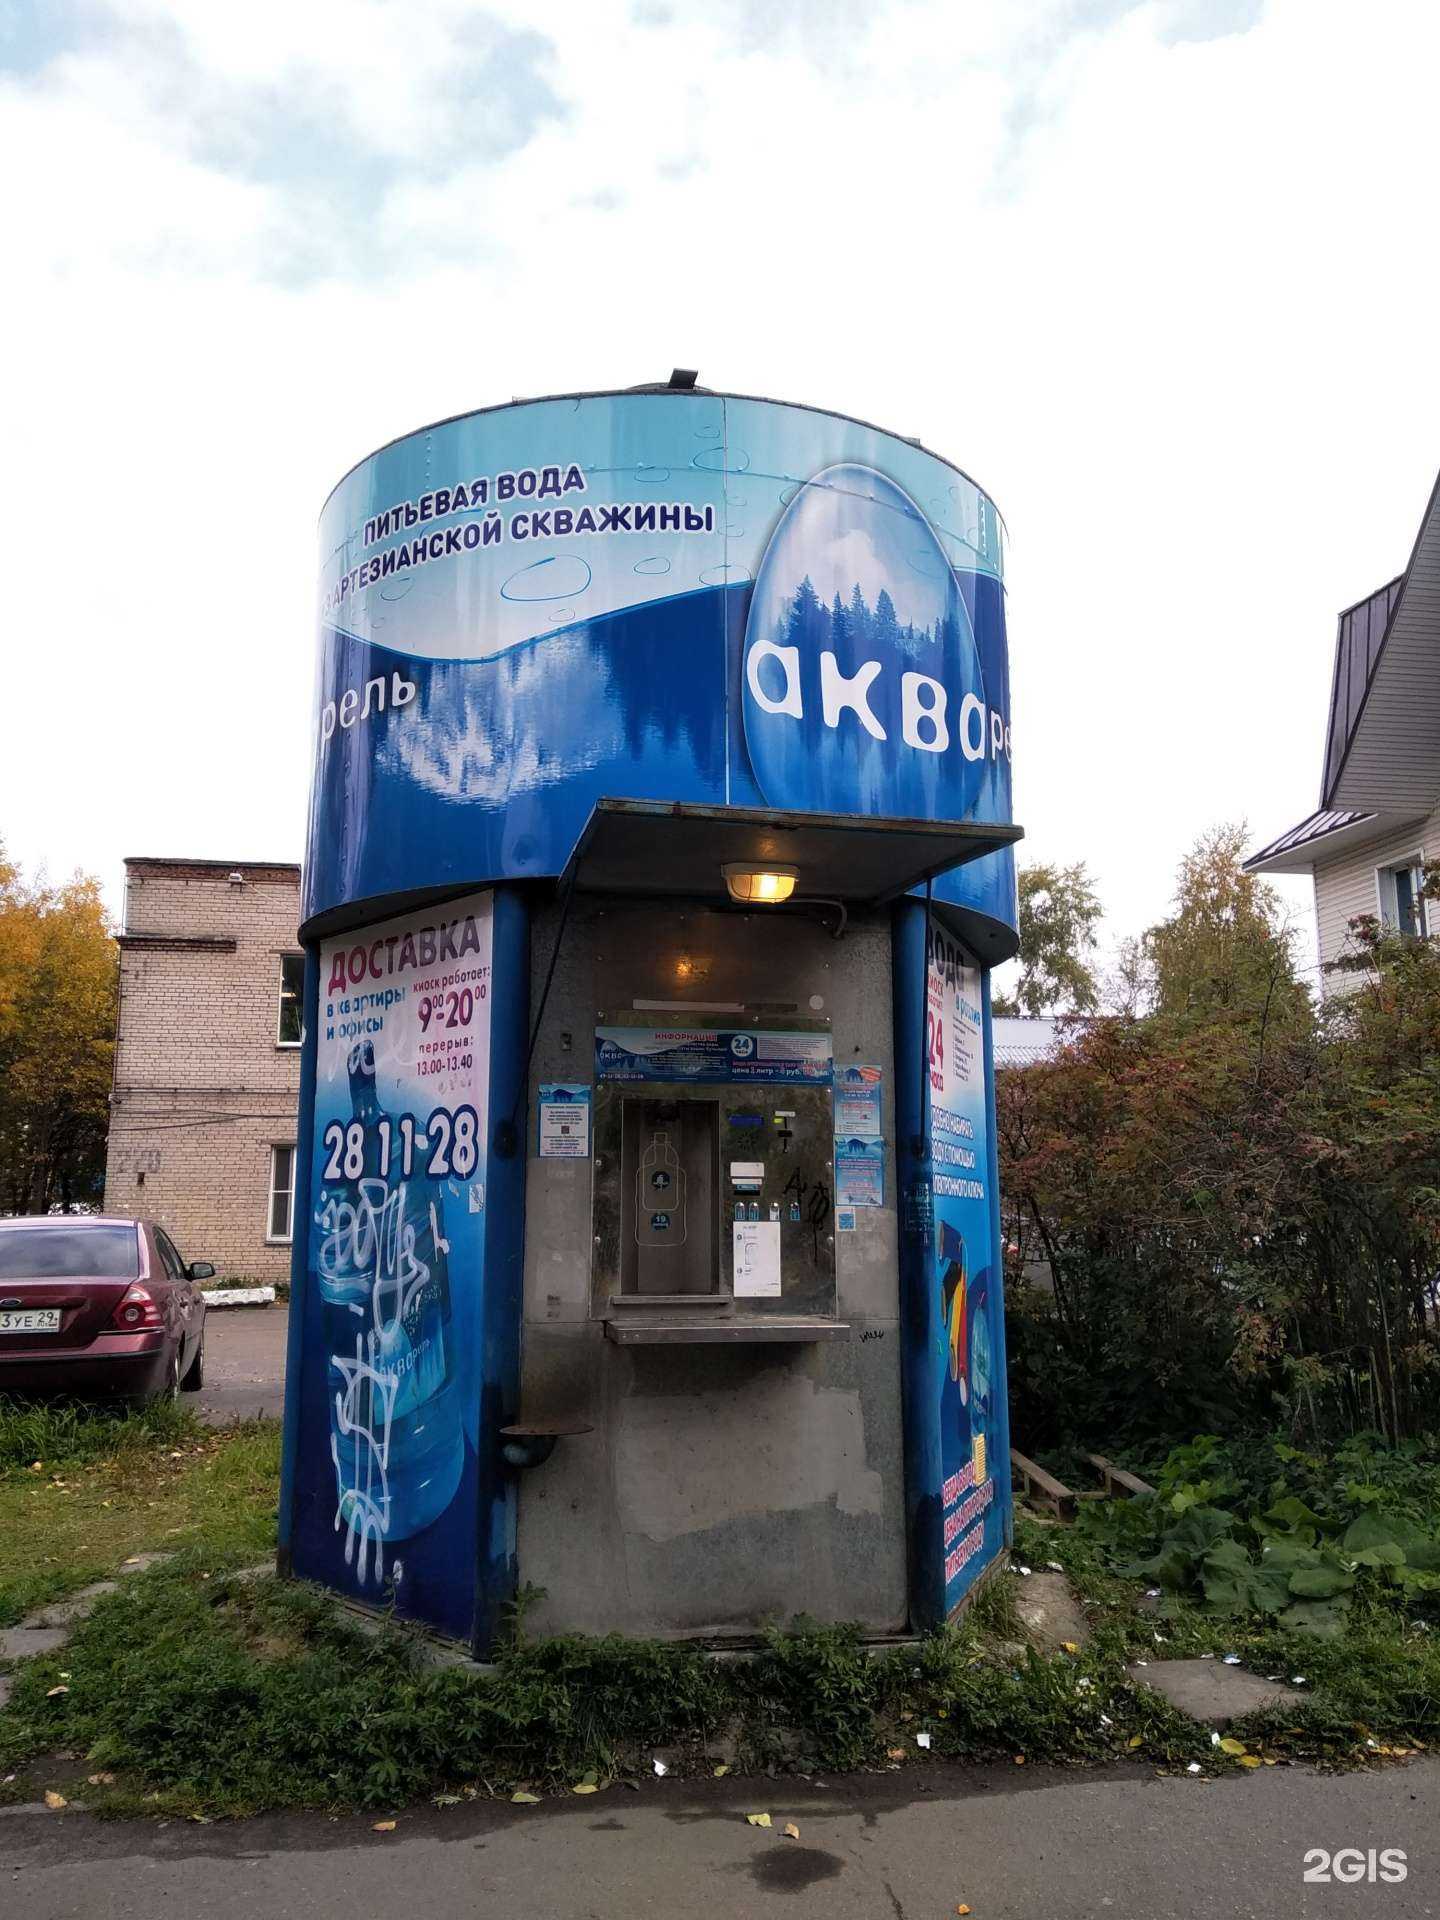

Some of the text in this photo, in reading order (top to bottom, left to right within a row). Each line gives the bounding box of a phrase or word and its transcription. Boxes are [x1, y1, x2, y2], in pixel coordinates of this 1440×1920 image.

[364, 465, 586, 547] ПИТЬЕВАЯ ВОДА
[332, 504, 713, 609] АРТЕЗИАНСКОЙ СКВАЖИНЫ
[328, 915, 481, 998] ДОСТАВКА
[413, 965, 491, 993] киоск работает:
[416, 1053, 474, 1076] 13.00-13.40
[419, 1035, 474, 1055] перерыв:
[322, 1121, 366, 1182] 28
